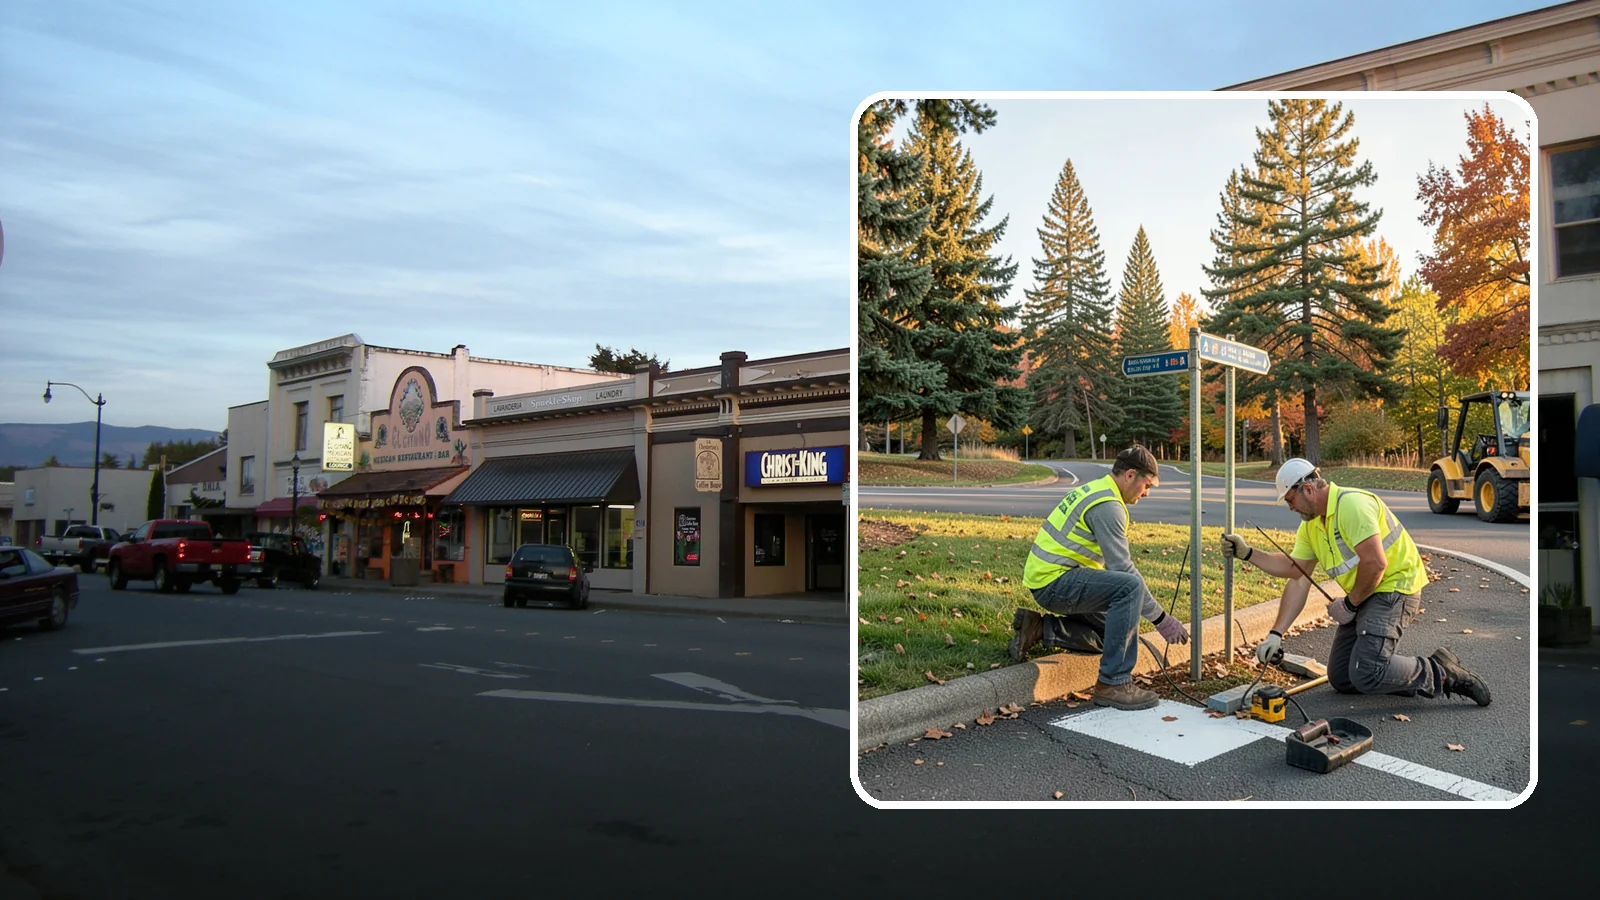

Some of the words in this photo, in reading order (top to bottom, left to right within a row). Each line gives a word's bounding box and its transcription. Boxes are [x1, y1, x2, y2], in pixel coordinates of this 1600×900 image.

[596, 389, 623, 400] LAUNDRY
[493, 402, 522, 413] LAVANDERIA
[531, 396, 561, 409] Sparkle
[561, 394, 582, 405] Shop
[373, 455, 396, 464] MEXICAN
[397, 451, 433, 462] RESTAURANT
[437, 450, 450, 459] BAR
